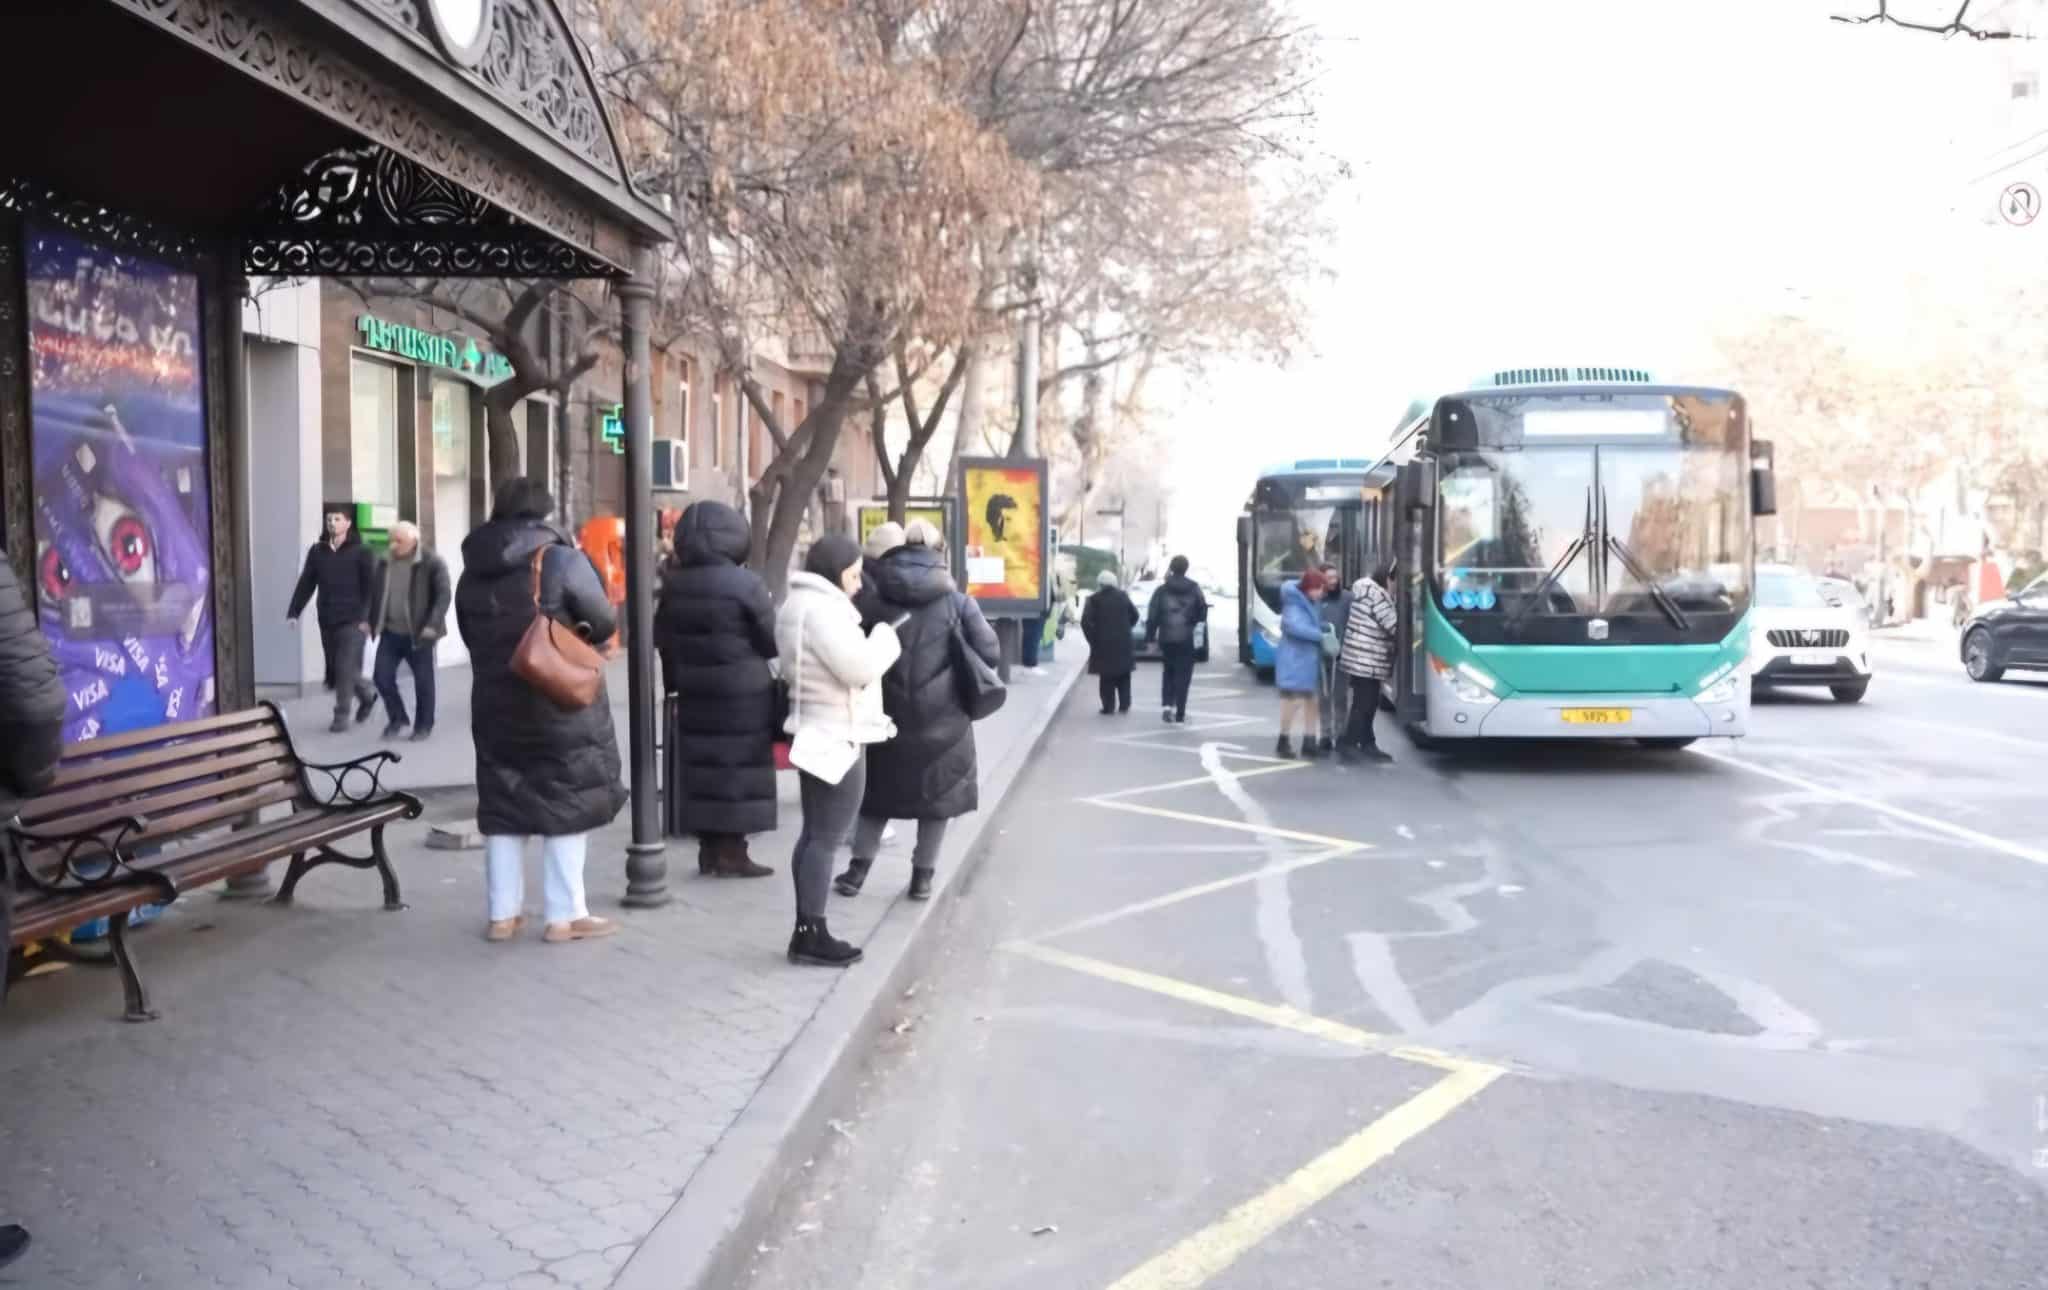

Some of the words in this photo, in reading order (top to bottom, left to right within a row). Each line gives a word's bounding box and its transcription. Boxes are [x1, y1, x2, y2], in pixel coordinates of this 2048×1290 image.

[95, 646, 125, 676] VISA
[123, 637, 150, 672] VISA
[72, 679, 109, 711] VISA
